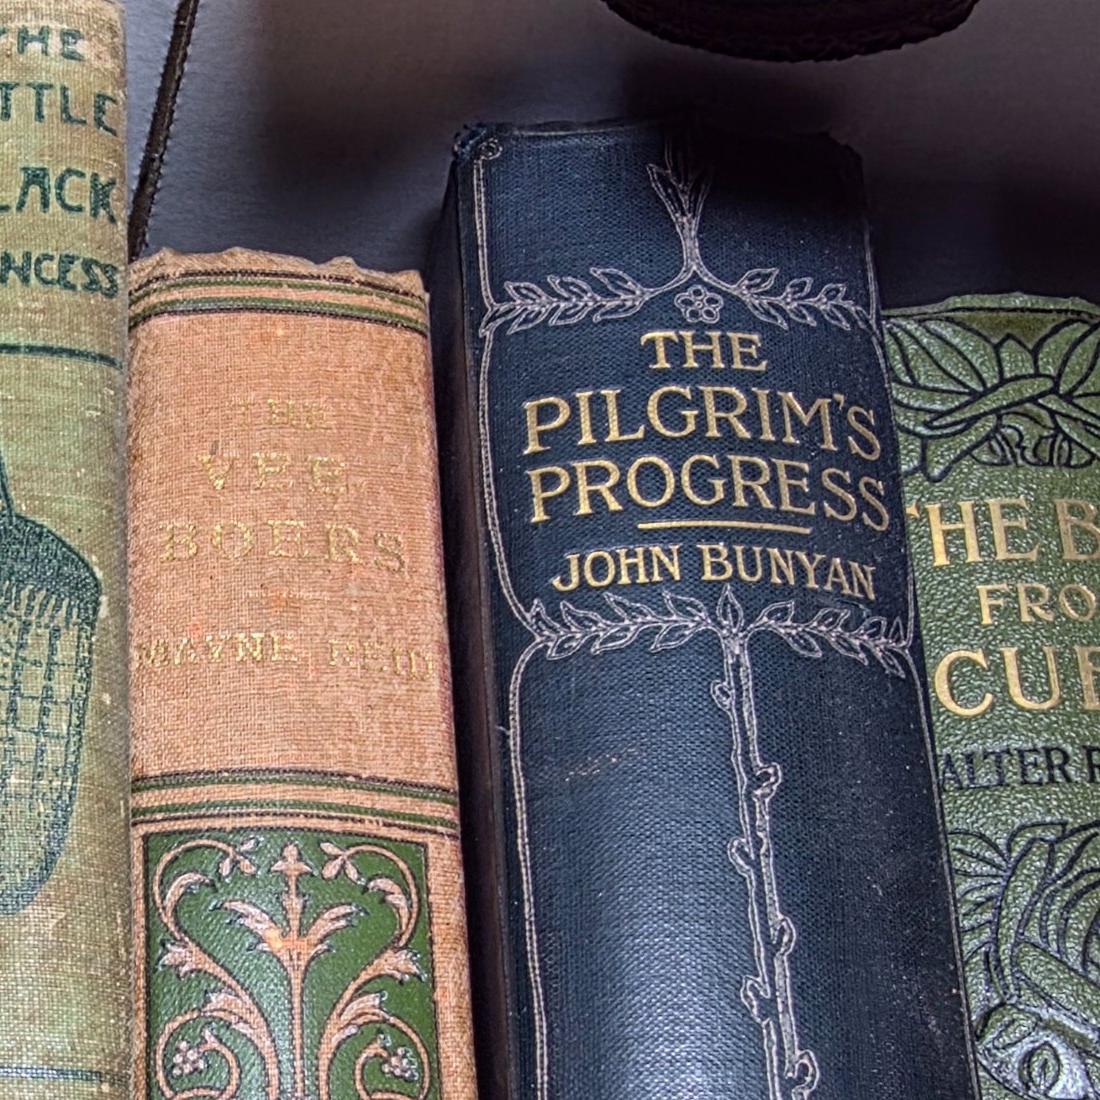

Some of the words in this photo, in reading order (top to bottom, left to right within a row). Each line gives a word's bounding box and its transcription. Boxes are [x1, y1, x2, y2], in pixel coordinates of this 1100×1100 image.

[640, 331, 768, 372] THE
[522, 386, 883, 460] PILGRIM'S
[526, 454, 891, 533] PROGRESS
[159, 520, 405, 574] BOERS
[905, 495, 1039, 567] HE
[551, 544, 680, 593] JOHN
[699, 542, 877, 601] BUNYAN
[939, 745, 1073, 792] ALTER
